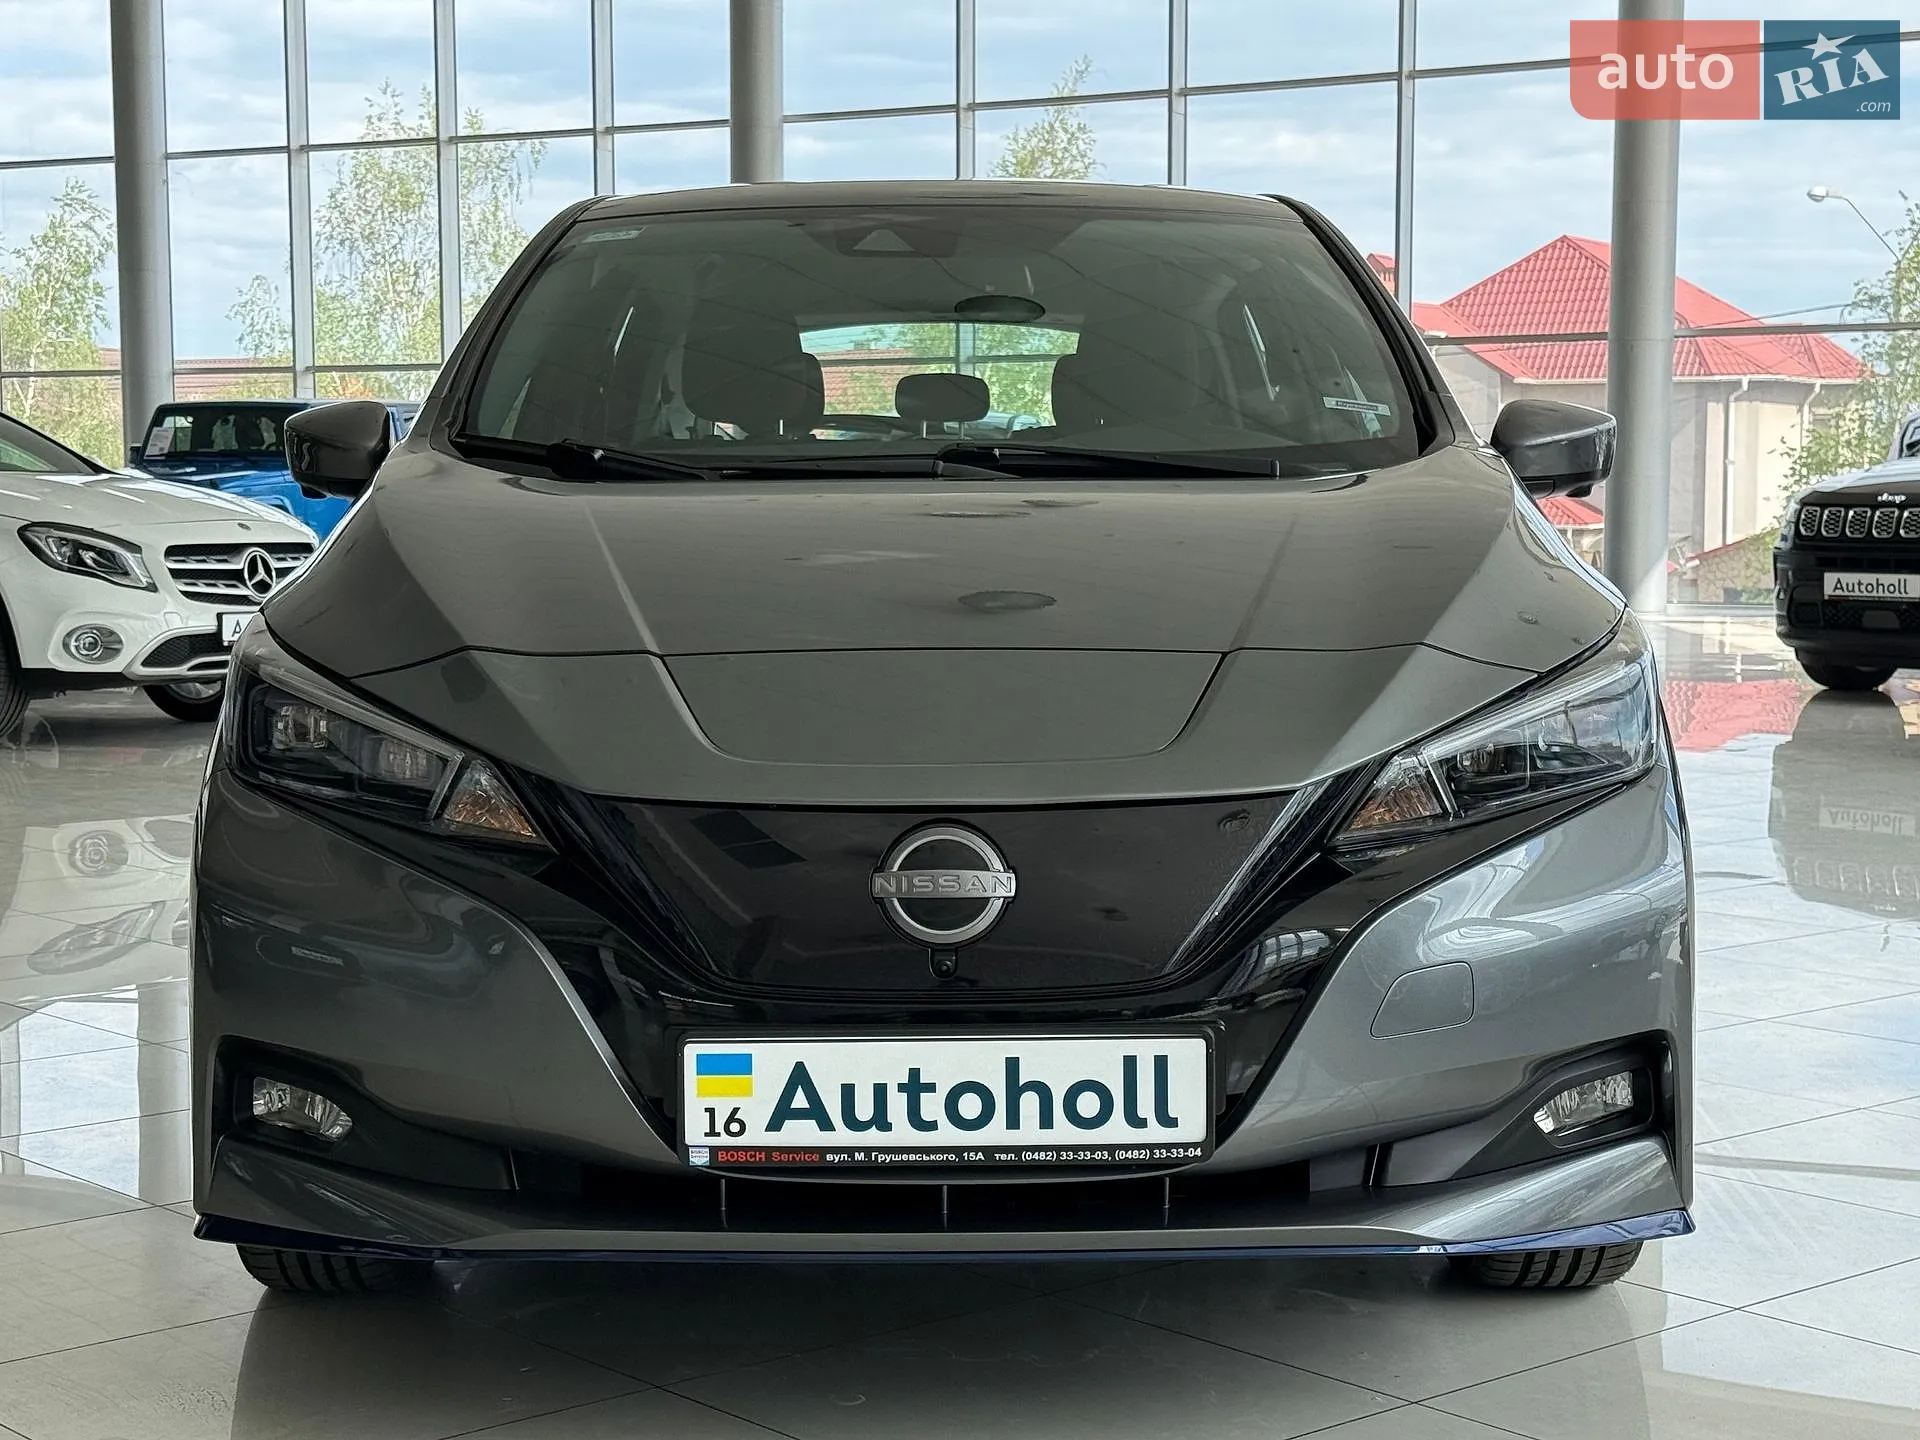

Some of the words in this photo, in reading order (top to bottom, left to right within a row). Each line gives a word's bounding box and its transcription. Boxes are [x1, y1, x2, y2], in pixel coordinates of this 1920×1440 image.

[1832, 577, 1910, 595] Autoholl
[874, 873, 1012, 895] NISSAN
[763, 1054, 1179, 1134] Autoholl
[703, 1106, 747, 1139] 16
[718, 1151, 765, 1162] BOSCH
[771, 1151, 820, 1162] Service
[826, 1153, 852, 1163] вул.
[854, 1152, 868, 1162] М.
[871, 1151, 959, 1163] Грушевського,
[994, 1153, 1018, 1161] тел.
[1021, 1151, 1057, 1162] (0482)
[1059, 1150, 1112, 1162] 33-33-03,
[1115, 1149, 1150, 1160] (0482)
[1153, 1147, 1202, 1159] 33-33-04
